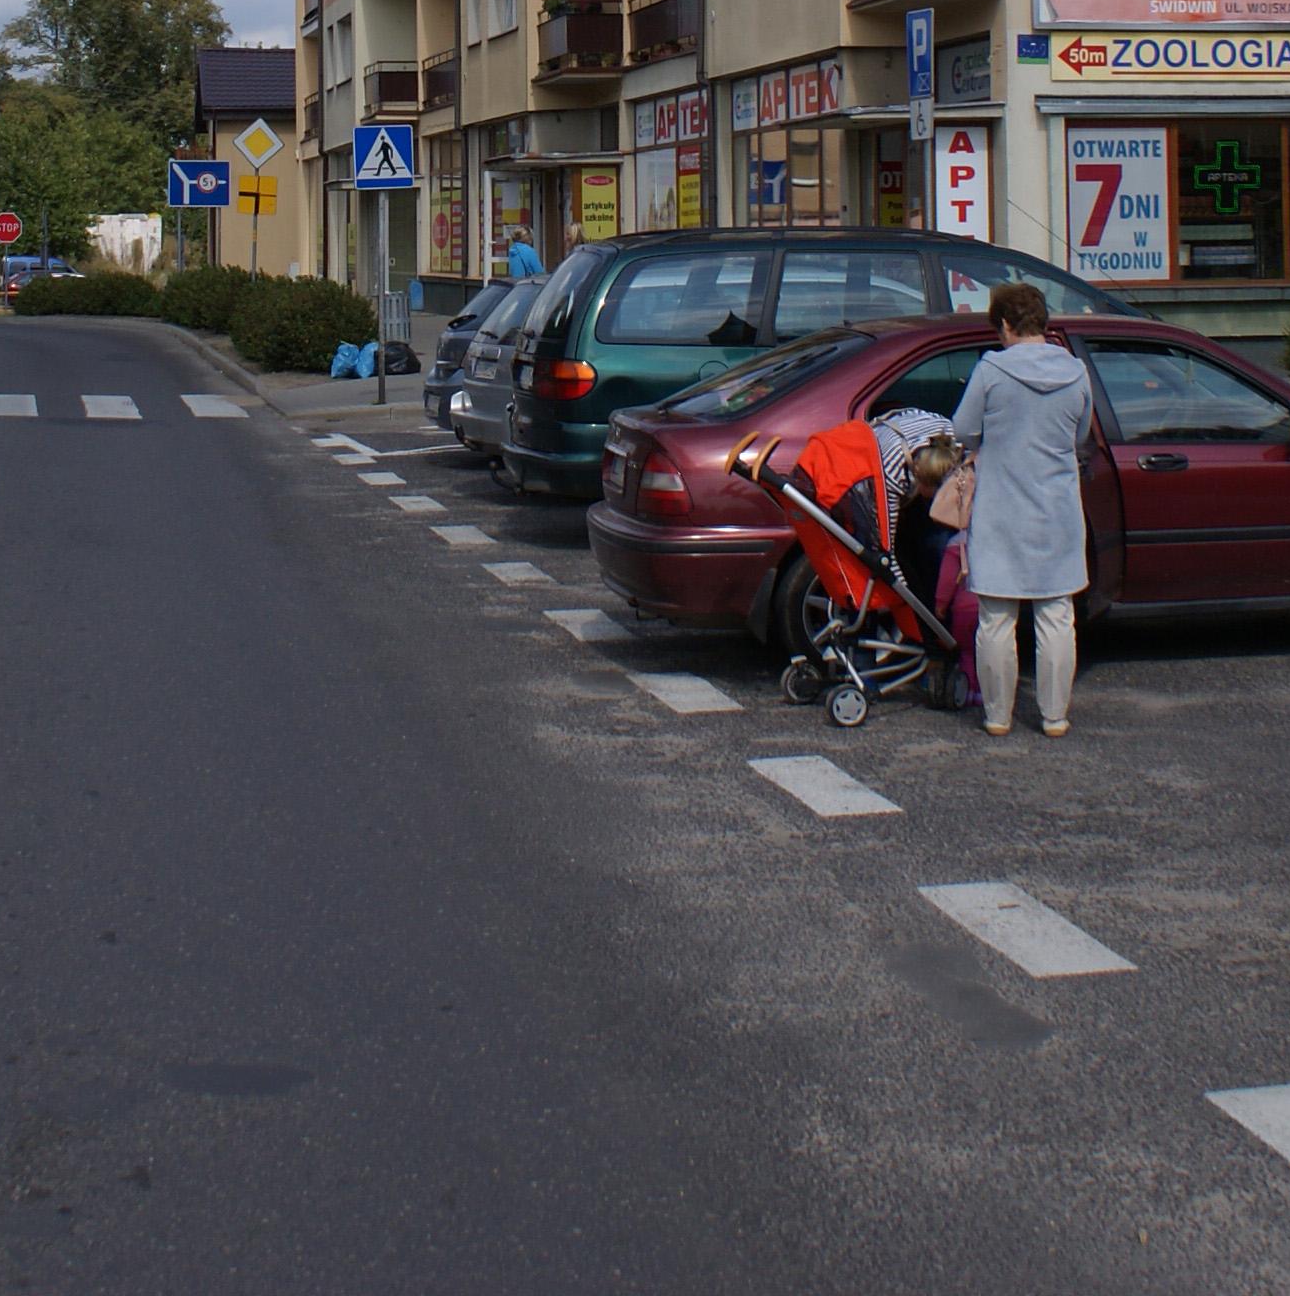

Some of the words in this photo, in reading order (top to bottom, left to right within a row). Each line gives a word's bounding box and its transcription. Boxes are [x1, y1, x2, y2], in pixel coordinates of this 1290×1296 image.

[1225, 2, 1244, 13] UL.
[912, 18, 927, 72] P
[1069, 48, 1105, 64] 50m
[760, 66, 838, 121] APTEK
[1073, 140, 1162, 158] OTWARTE
[1207, 172, 1249, 182] APTEKA
[1075, 164, 1123, 247] 7
[1119, 195, 1159, 219] DNI
[1133, 232, 1148, 247] W
[1078, 251, 1163, 271] TYGODNIU
